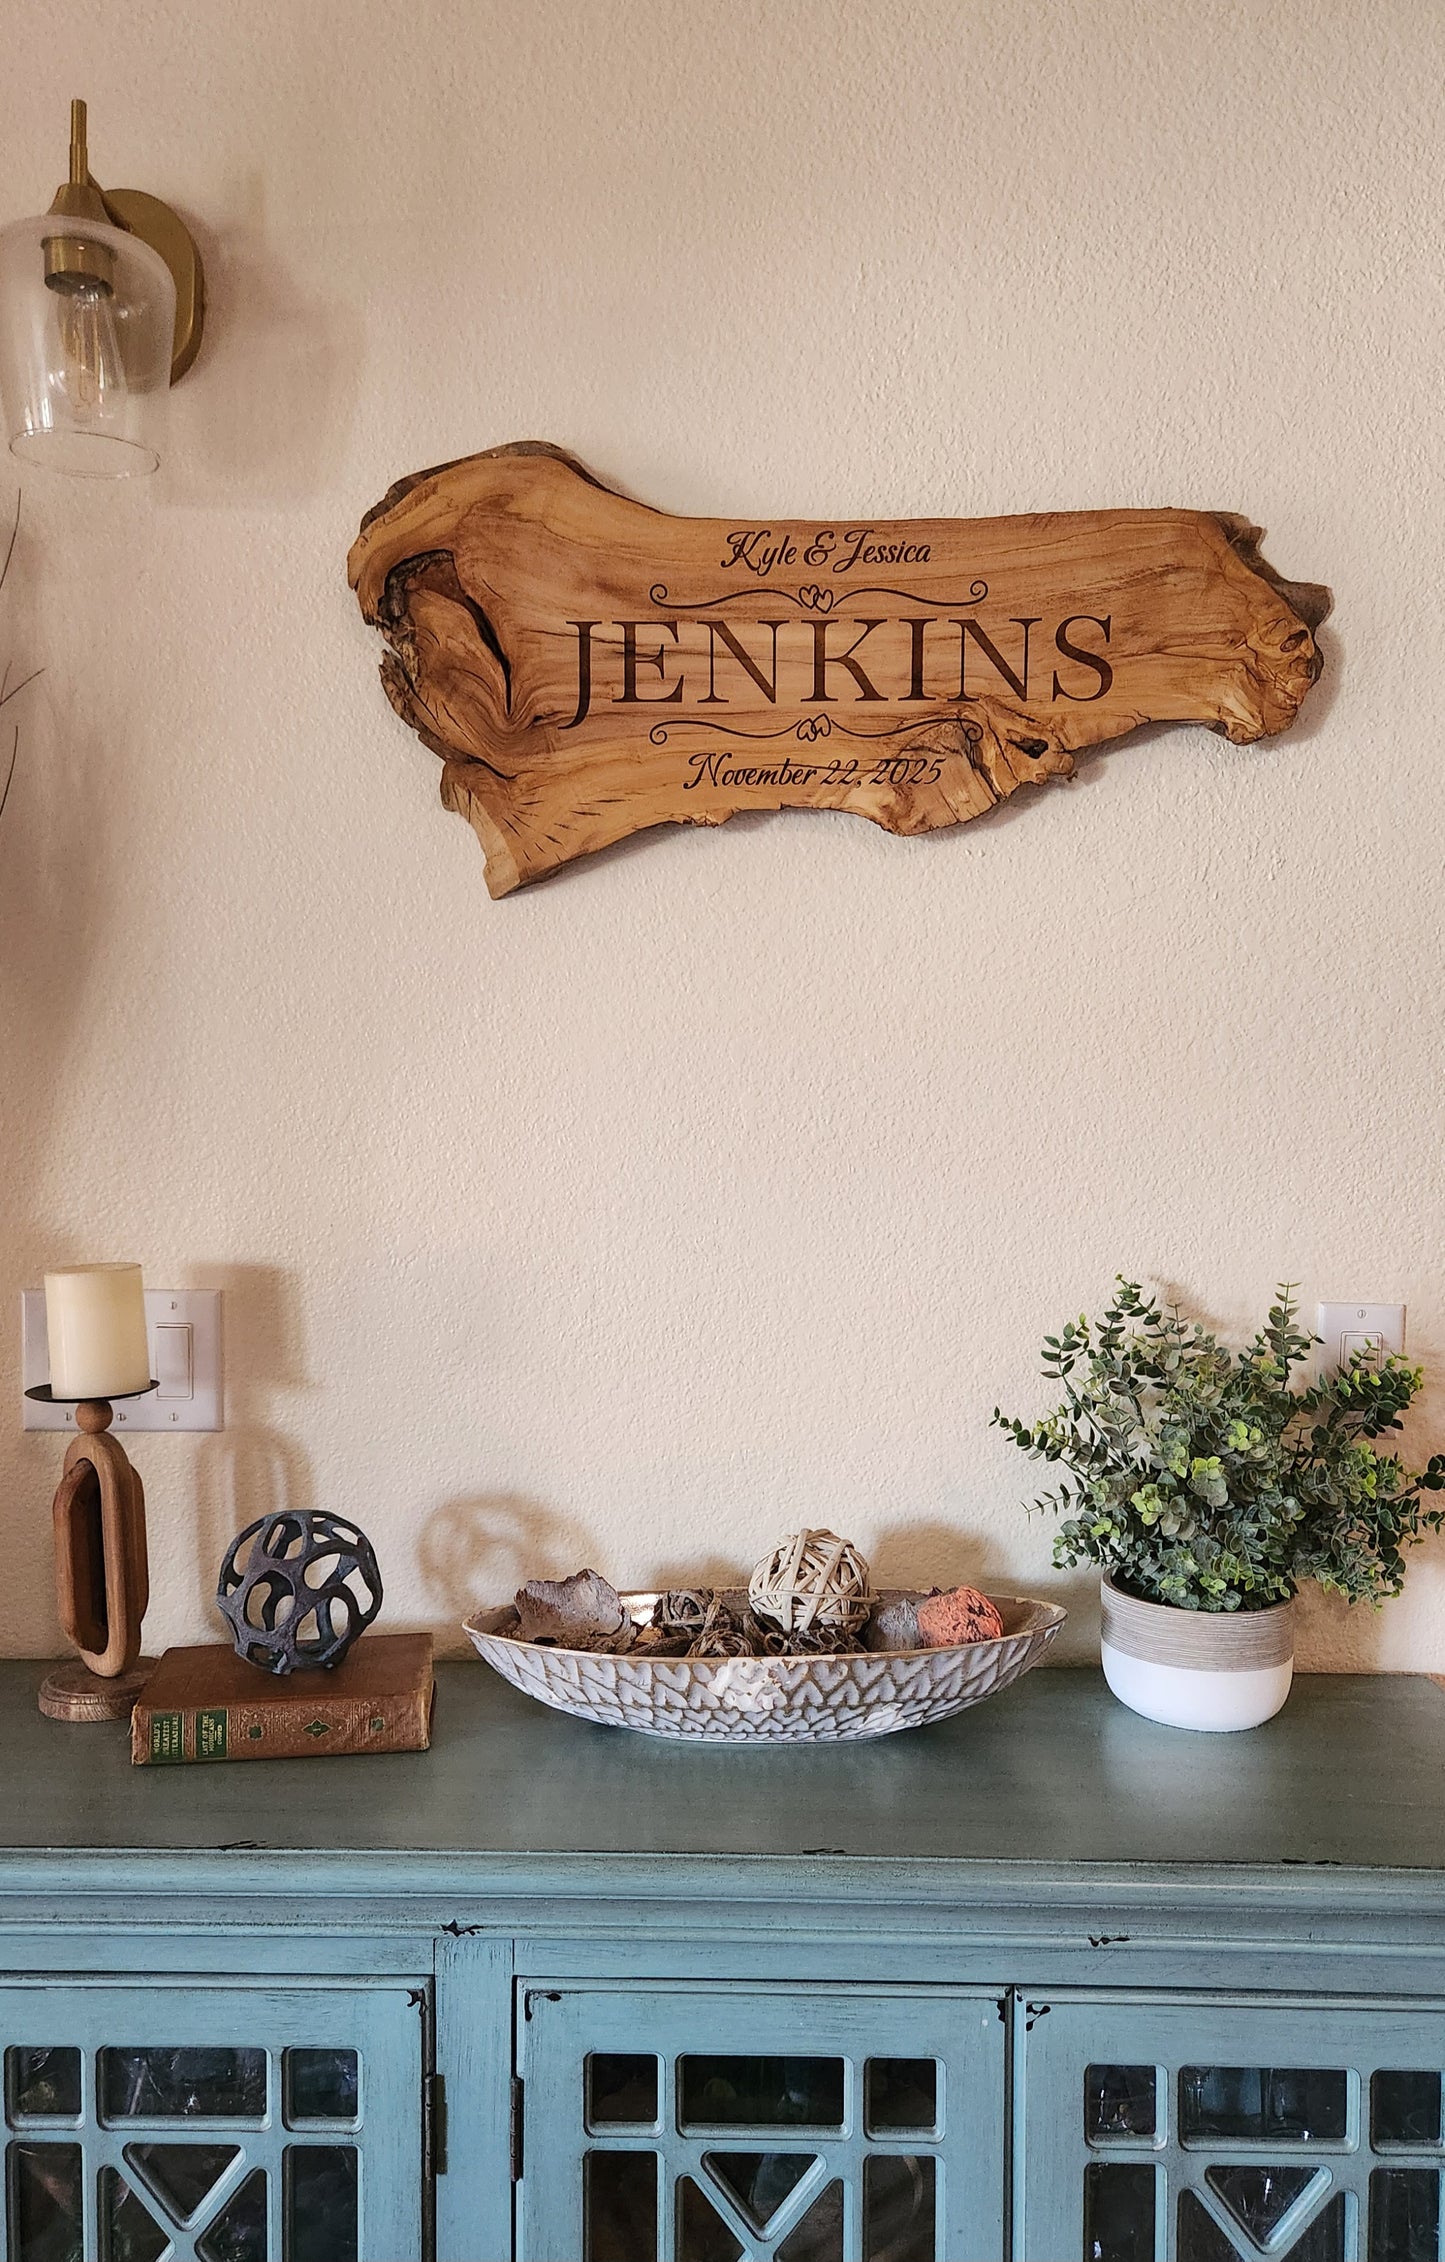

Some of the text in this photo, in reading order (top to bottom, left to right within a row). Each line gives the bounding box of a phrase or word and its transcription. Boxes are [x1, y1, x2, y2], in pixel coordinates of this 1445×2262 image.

[720, 528, 932, 577] Kyle & Jessica
[557, 613, 1115, 730] JENKINS
[682, 752, 947, 790] November 22, 2025
[201, 1714, 209, 1728] THE
[201, 1728, 209, 1739] OF
